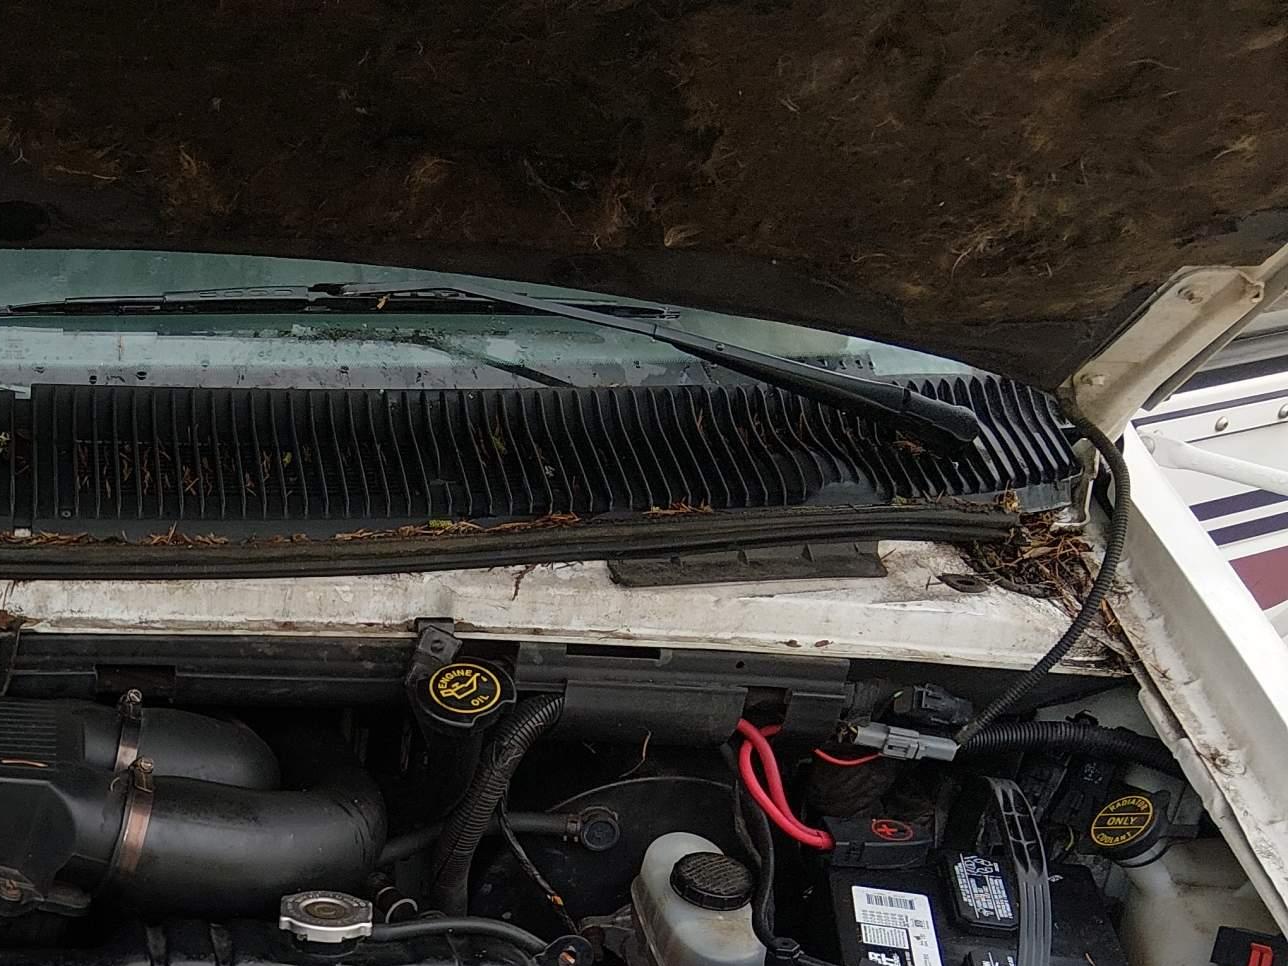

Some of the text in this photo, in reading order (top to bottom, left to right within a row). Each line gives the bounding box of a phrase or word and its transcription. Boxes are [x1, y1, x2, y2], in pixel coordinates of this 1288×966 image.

[438, 669, 473, 689] ENGINE
[471, 695, 490, 706] OIL
[1109, 800, 1149, 812] RADIATOR
[1107, 816, 1138, 826] ONLY
[1096, 832, 1132, 844] COOLANT
